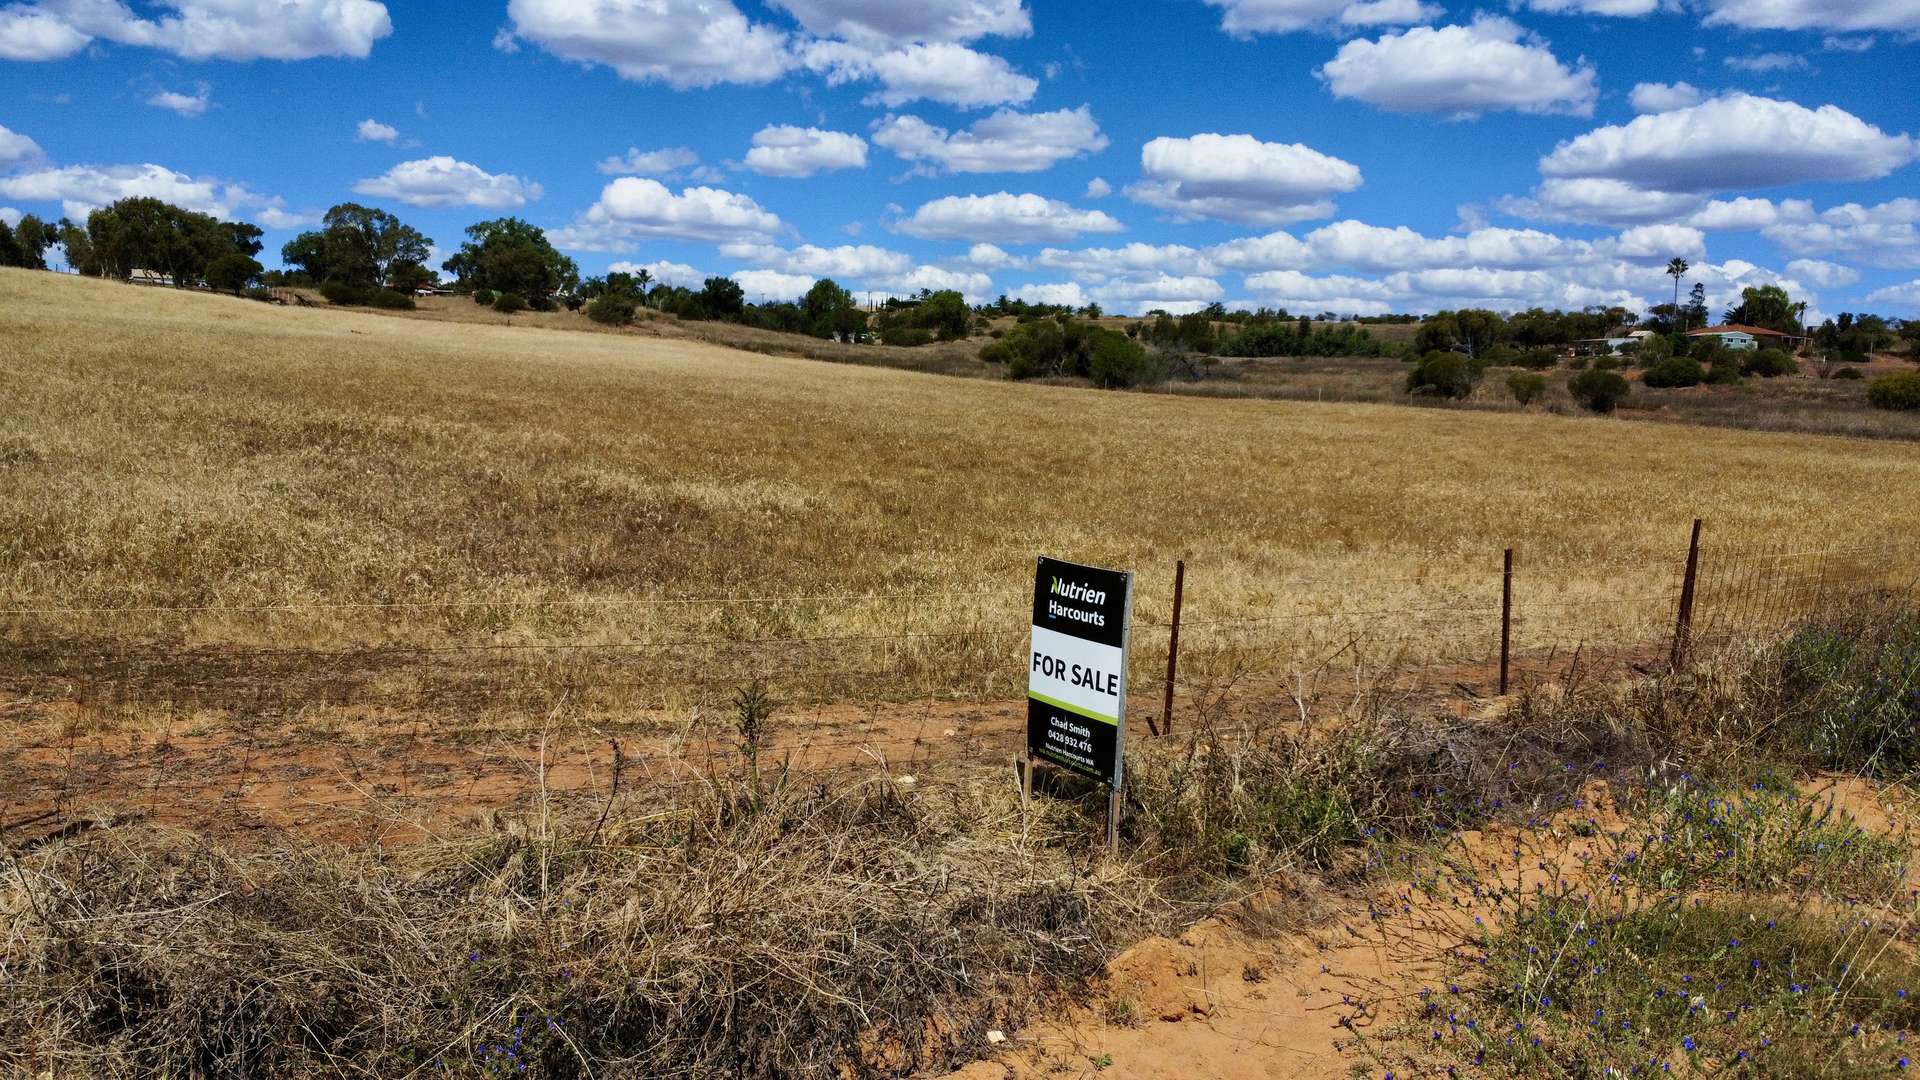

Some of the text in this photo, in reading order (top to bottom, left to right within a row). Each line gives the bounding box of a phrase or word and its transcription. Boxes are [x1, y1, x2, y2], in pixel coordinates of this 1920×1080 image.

[1051, 576, 1106, 605] Nutrien
[1049, 600, 1105, 626] Harcourts
[1033, 652, 1118, 696] FOR SALE
[1051, 717, 1091, 738] Chad Smith
[1048, 730, 1092, 753] 0428 932 476
